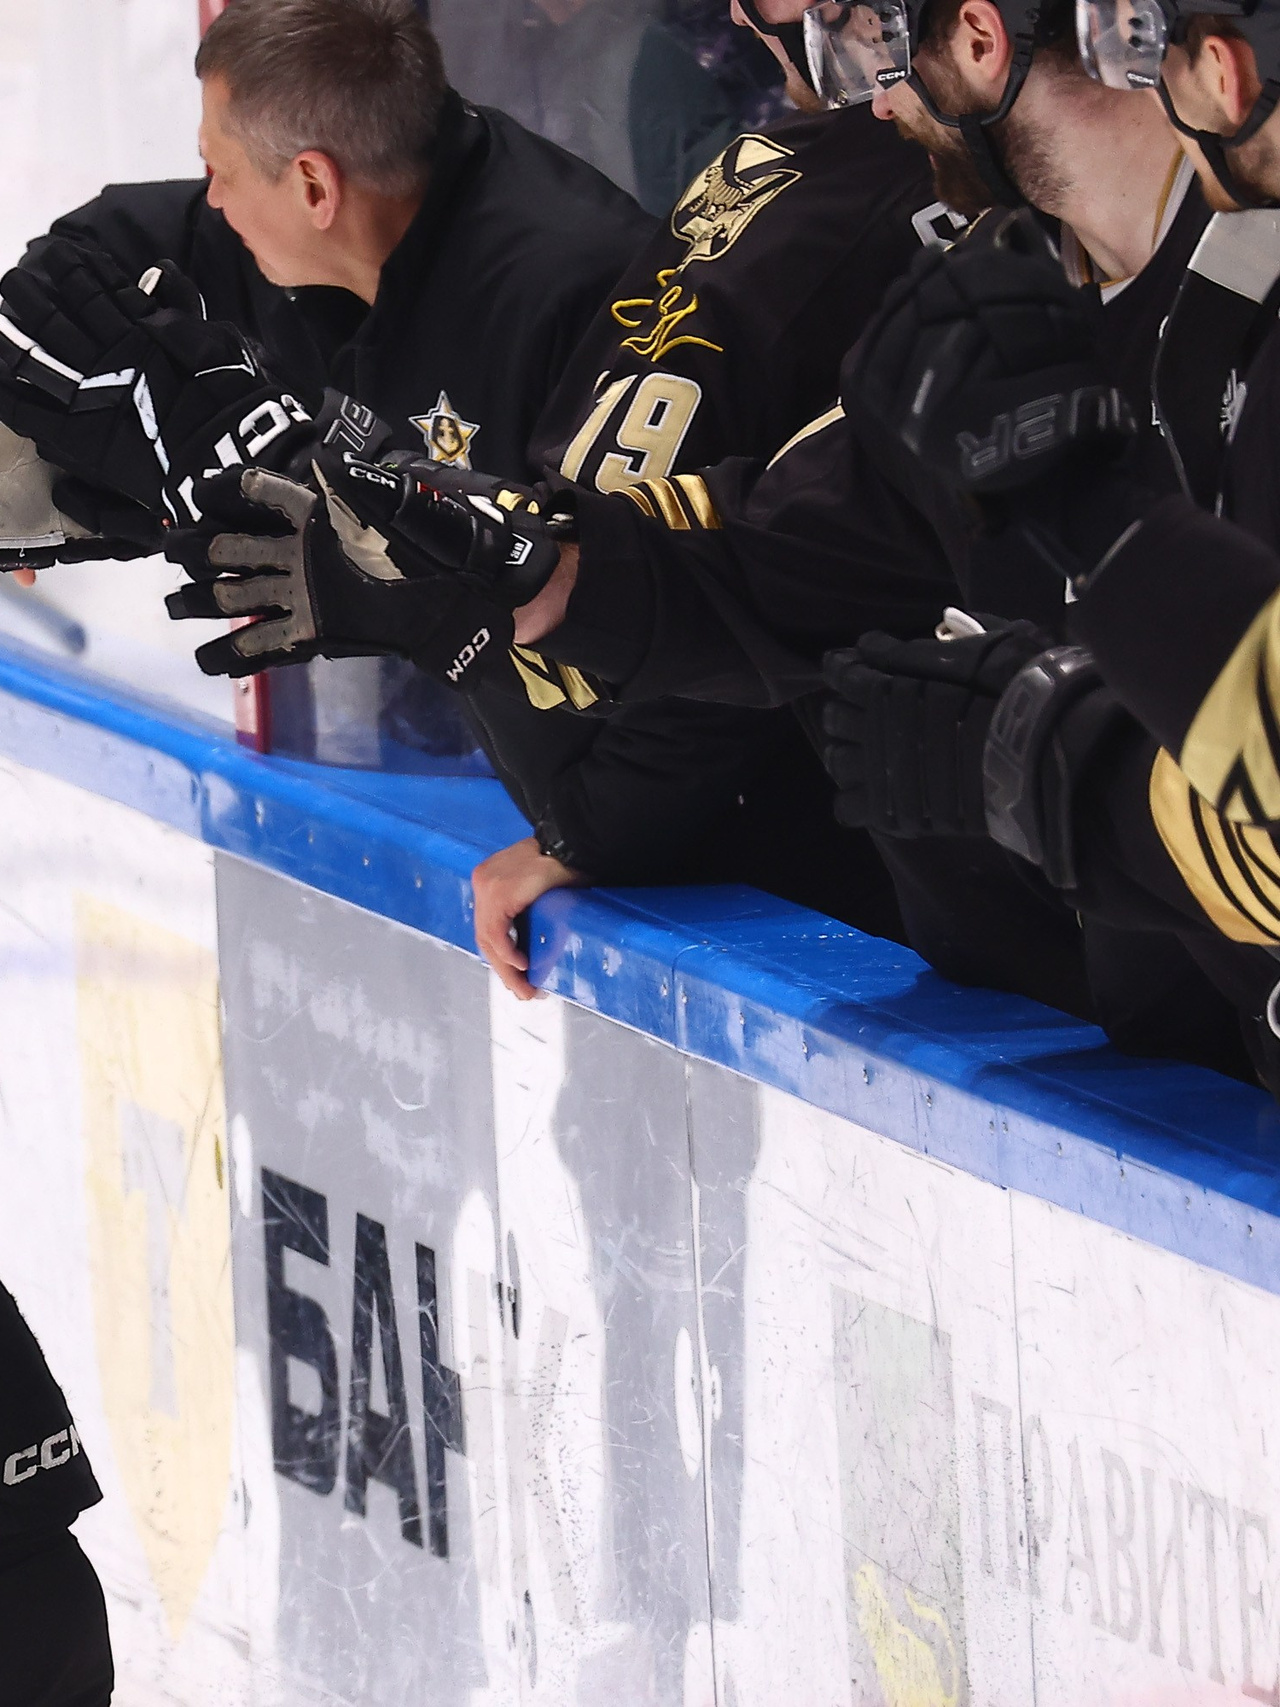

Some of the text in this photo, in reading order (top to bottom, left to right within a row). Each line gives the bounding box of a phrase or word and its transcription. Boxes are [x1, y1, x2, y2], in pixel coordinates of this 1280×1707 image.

[877, 70, 906, 82] CCM
[561, 371, 703, 494] 19
[349, 466, 397, 490] CCM
[445, 627, 492, 683] CCM
